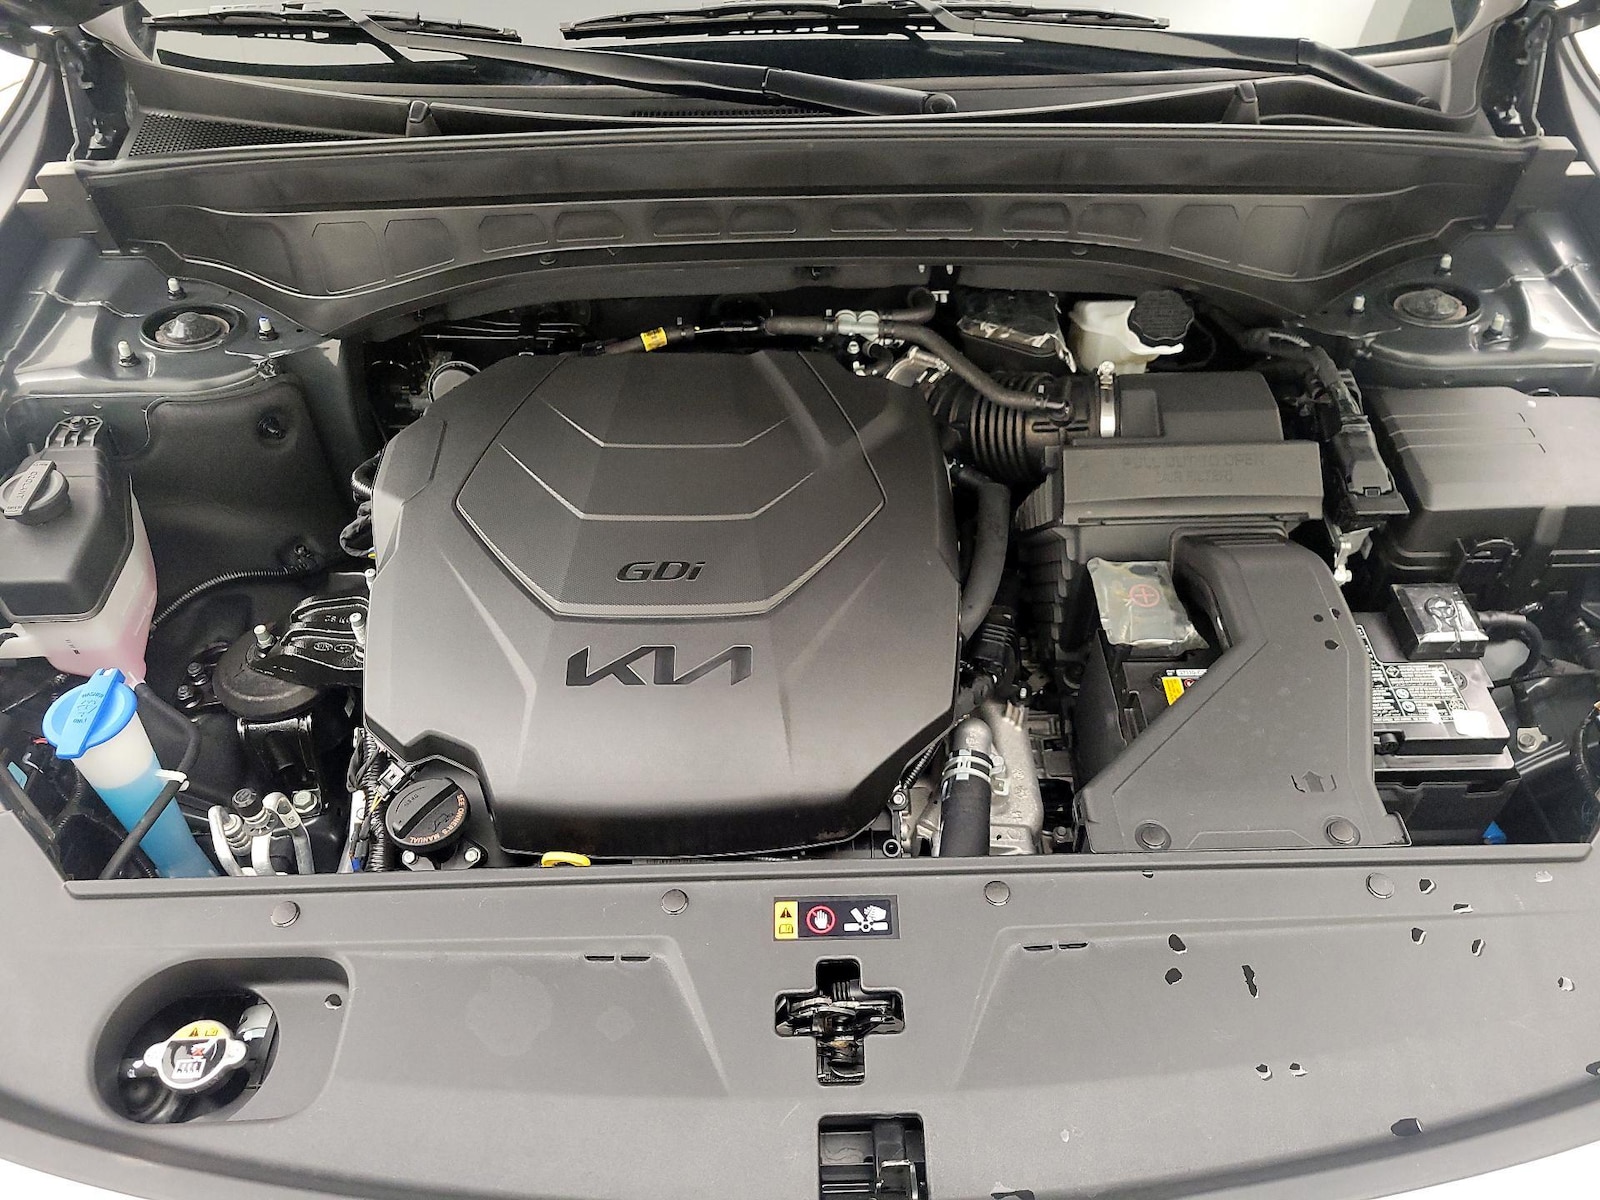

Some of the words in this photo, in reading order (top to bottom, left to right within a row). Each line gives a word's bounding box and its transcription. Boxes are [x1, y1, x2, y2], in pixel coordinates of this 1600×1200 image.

[616, 560, 706, 582] GDi
[566, 644, 753, 686] KIA
[456, 793, 466, 807] SEE
[441, 807, 465, 835] OWNER'S
[409, 832, 441, 844] MANUAL
